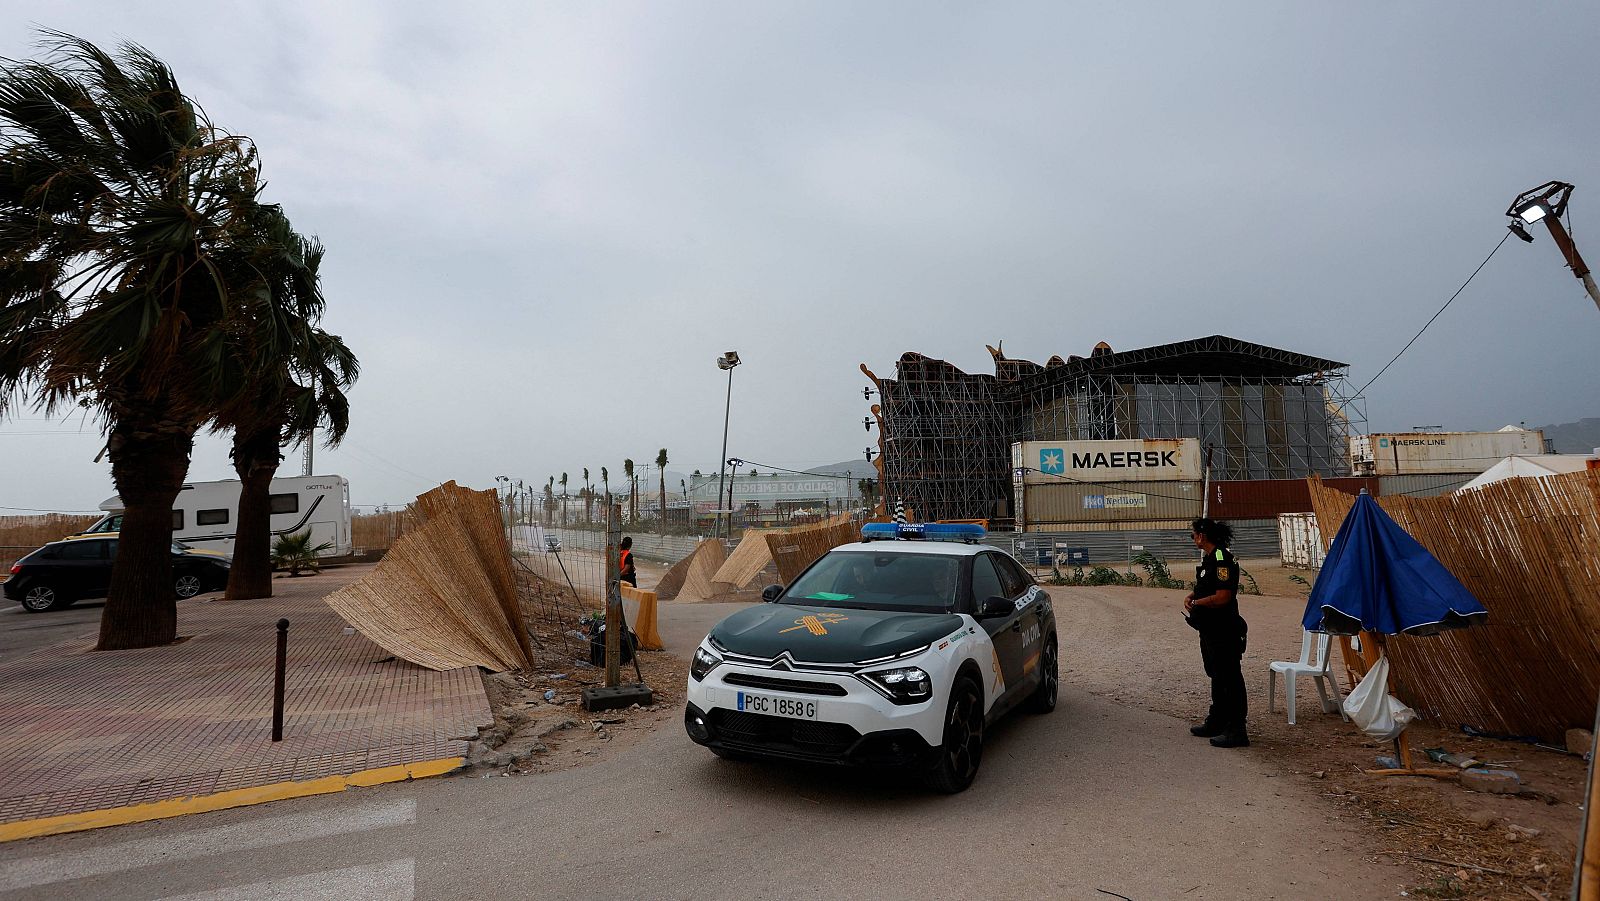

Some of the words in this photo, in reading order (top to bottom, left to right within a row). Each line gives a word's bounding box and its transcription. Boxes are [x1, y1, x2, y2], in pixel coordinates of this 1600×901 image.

[1072, 450, 1177, 469] MAERSK
[1105, 495, 1144, 508] Nedlloyd
[745, 694, 769, 712] PGC
[773, 698, 804, 716] 1858
[806, 702, 815, 718] G
